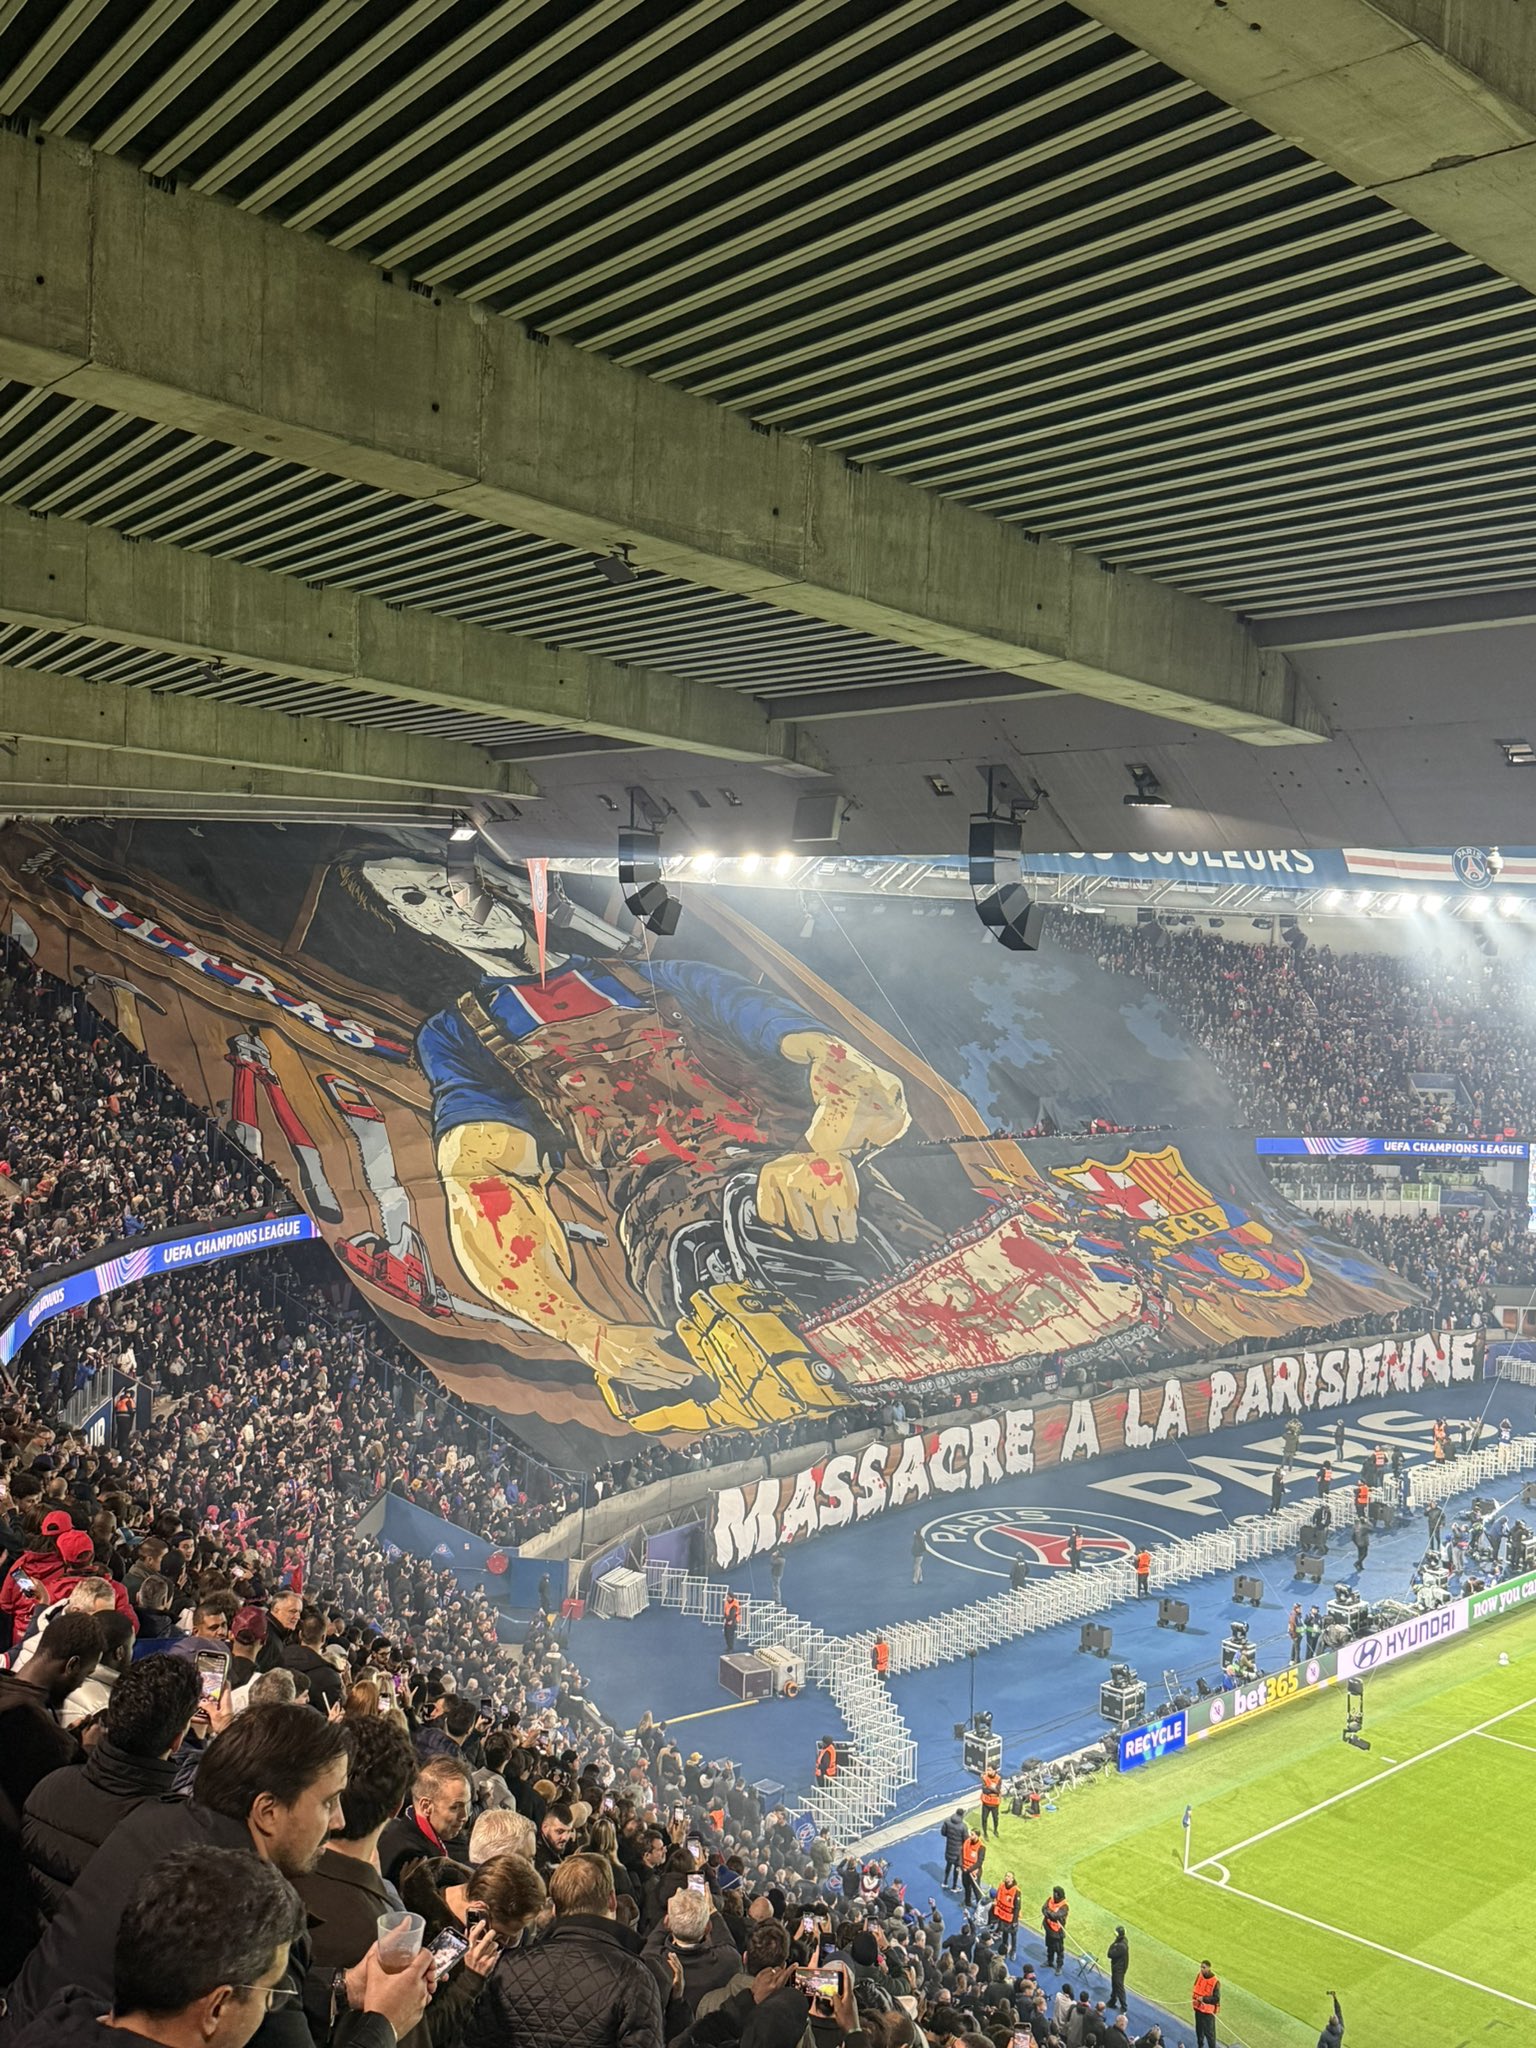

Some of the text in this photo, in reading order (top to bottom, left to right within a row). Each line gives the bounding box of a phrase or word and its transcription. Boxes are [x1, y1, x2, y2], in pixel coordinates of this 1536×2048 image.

[1384, 1141, 1525, 1155] UEFA CHAMPIONS LEAGUE
[164, 1220, 301, 1263] UEFA CHAMPIONS LEAGUE
[1160, 1211, 1220, 1243] FCB
[713, 1332, 1477, 1570] MASSACRE A LA PARISIENNE
[1088, 1410, 1499, 1516] PARIS
[931, 1510, 1051, 1544] PARIS
[1473, 1601, 1498, 1618] now
[1499, 1586, 1520, 1612] you
[1386, 1609, 1455, 1657] HYUNDAI
[1234, 1667, 1299, 1716] bet365
[1125, 1720, 1182, 1759] RECYCLE
